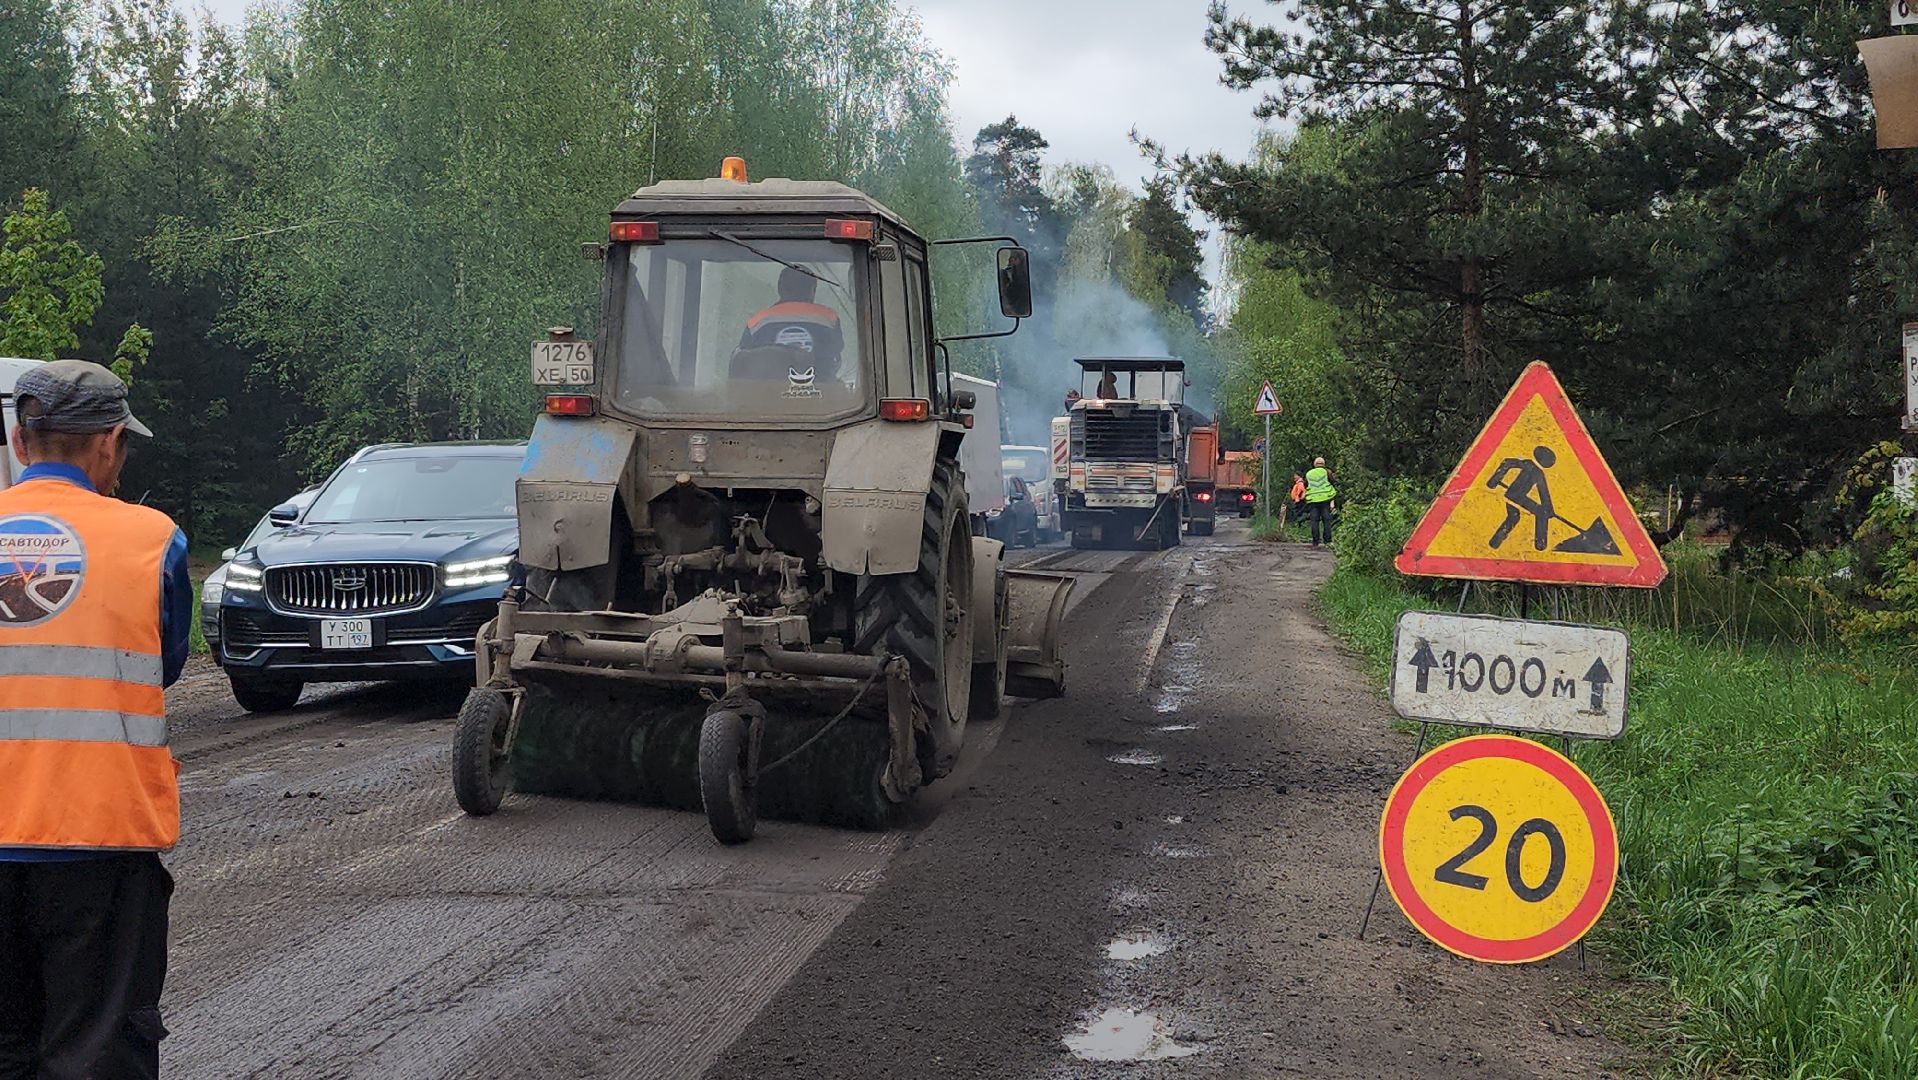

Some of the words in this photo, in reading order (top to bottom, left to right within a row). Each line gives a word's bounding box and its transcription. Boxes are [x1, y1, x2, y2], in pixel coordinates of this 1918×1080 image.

[541, 344, 586, 362] 1276
[571, 368, 589, 381] 50
[520, 489, 609, 503] BELARUS
[828, 497, 921, 512] BELARUS
[341, 621, 363, 632] 300
[327, 635, 344, 646] ТТ
[351, 635, 367, 645] 197
[1434, 804, 1566, 903] 20
